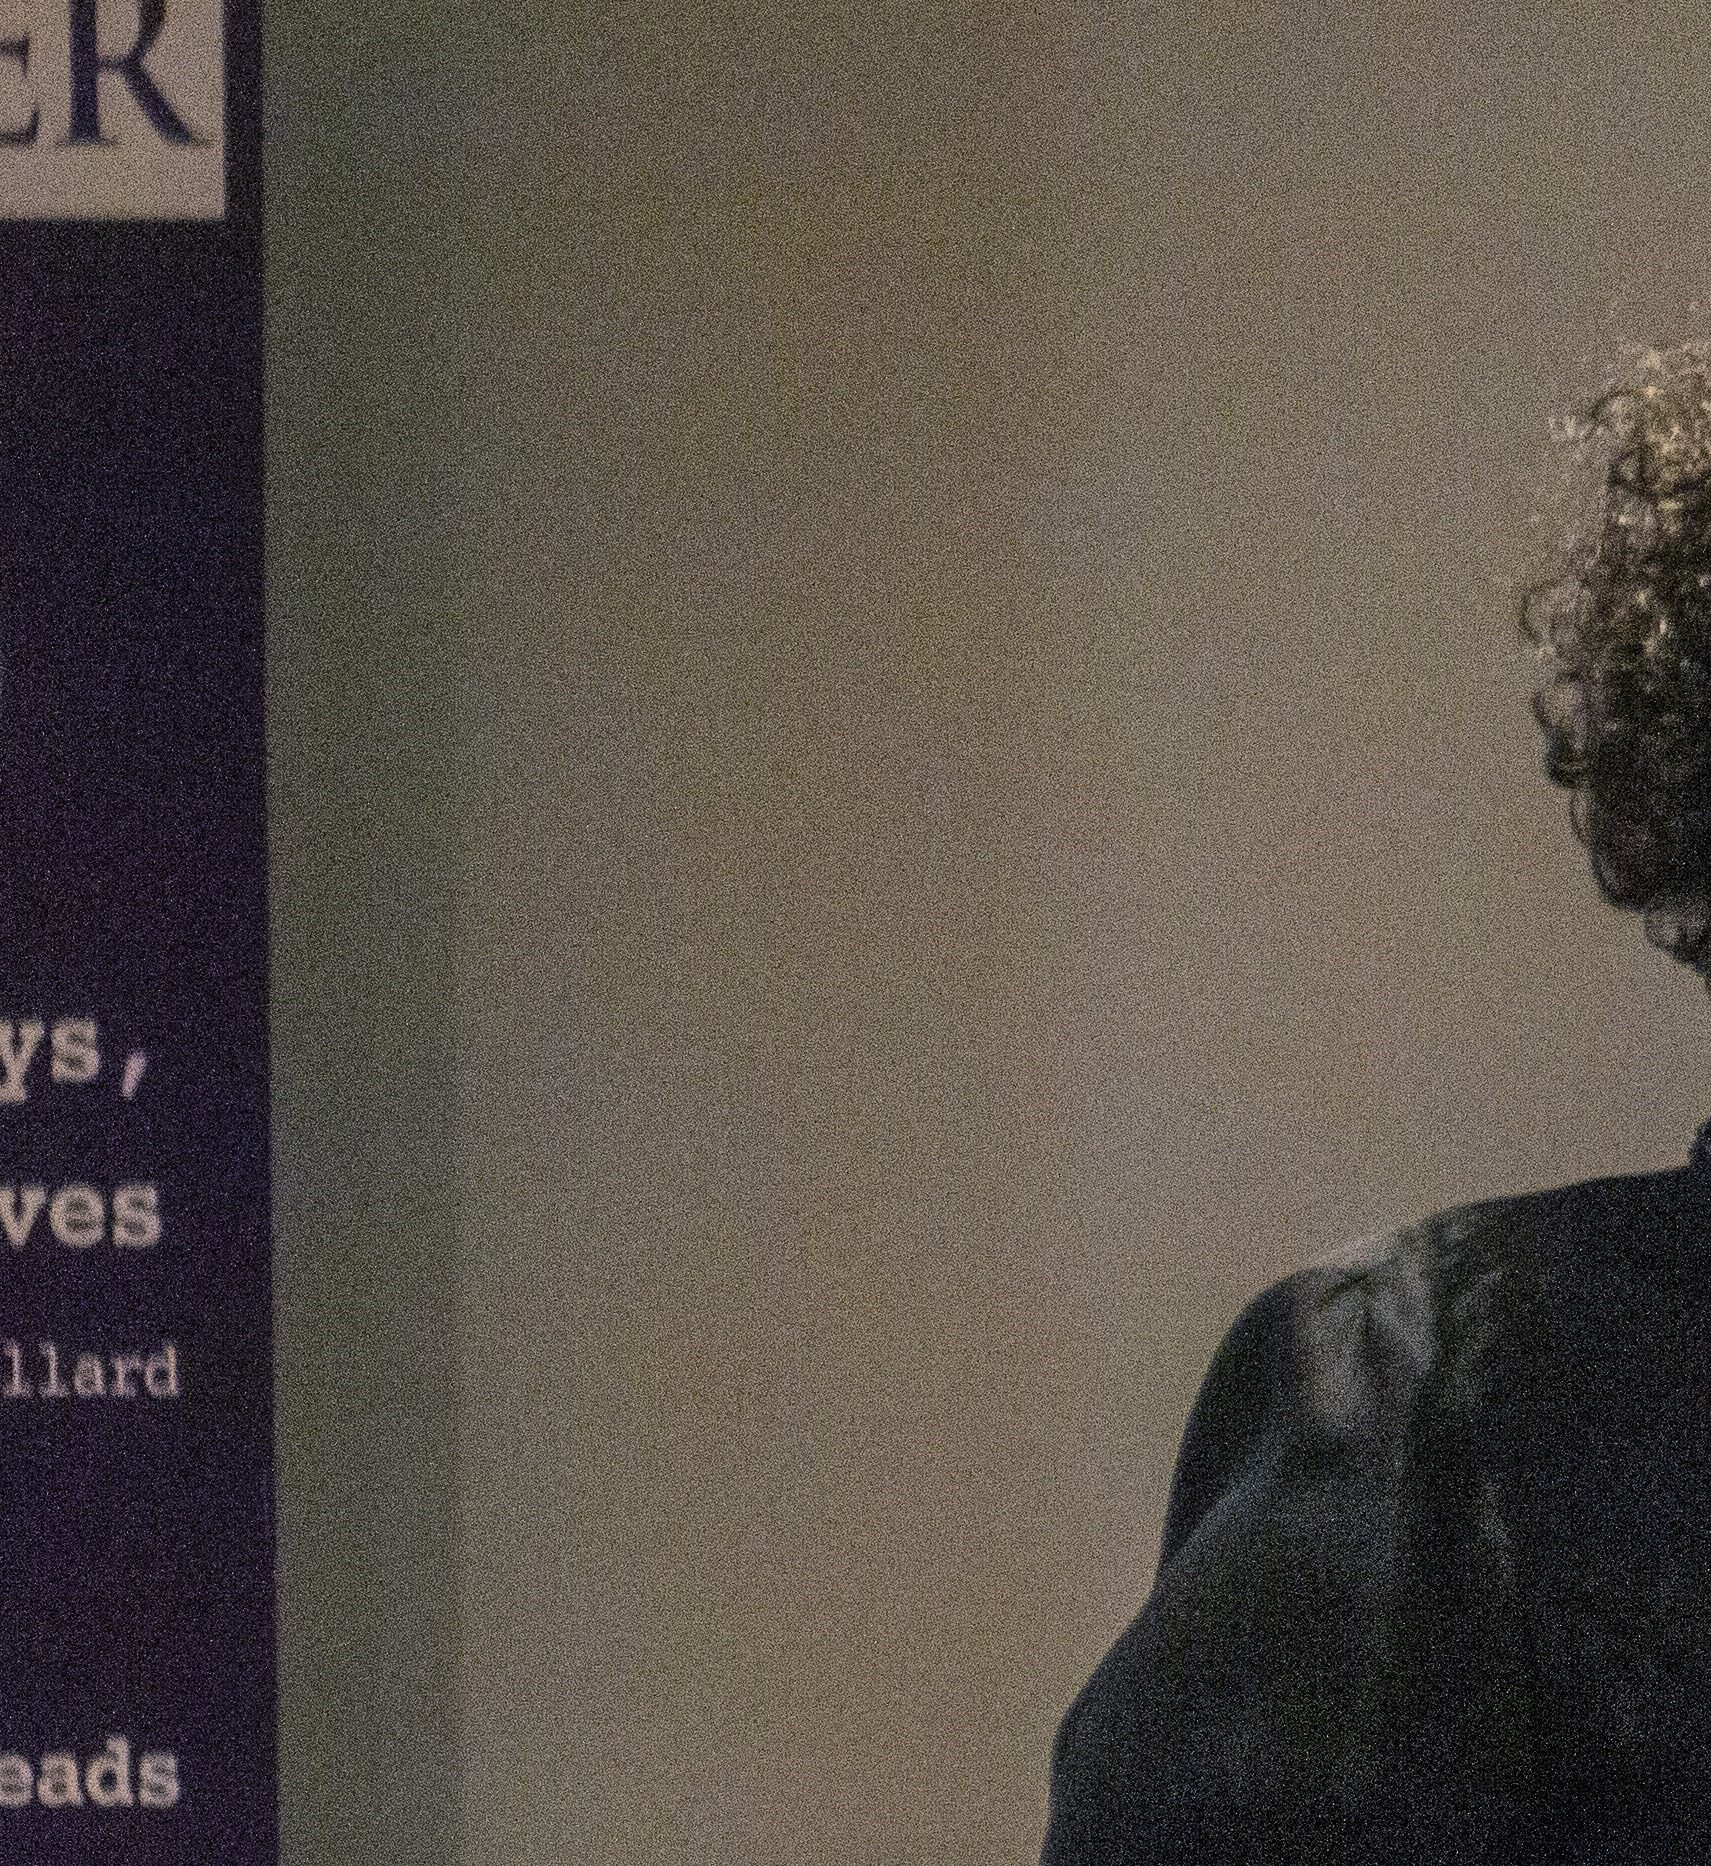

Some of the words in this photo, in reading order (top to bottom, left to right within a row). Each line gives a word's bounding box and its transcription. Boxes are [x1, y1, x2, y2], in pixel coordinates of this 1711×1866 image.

[0, 1017, 148, 1101] ys,
[0, 1184, 161, 1249] ves
[0, 1338, 178, 1398] llard
[0, 1734, 179, 1808] eads
